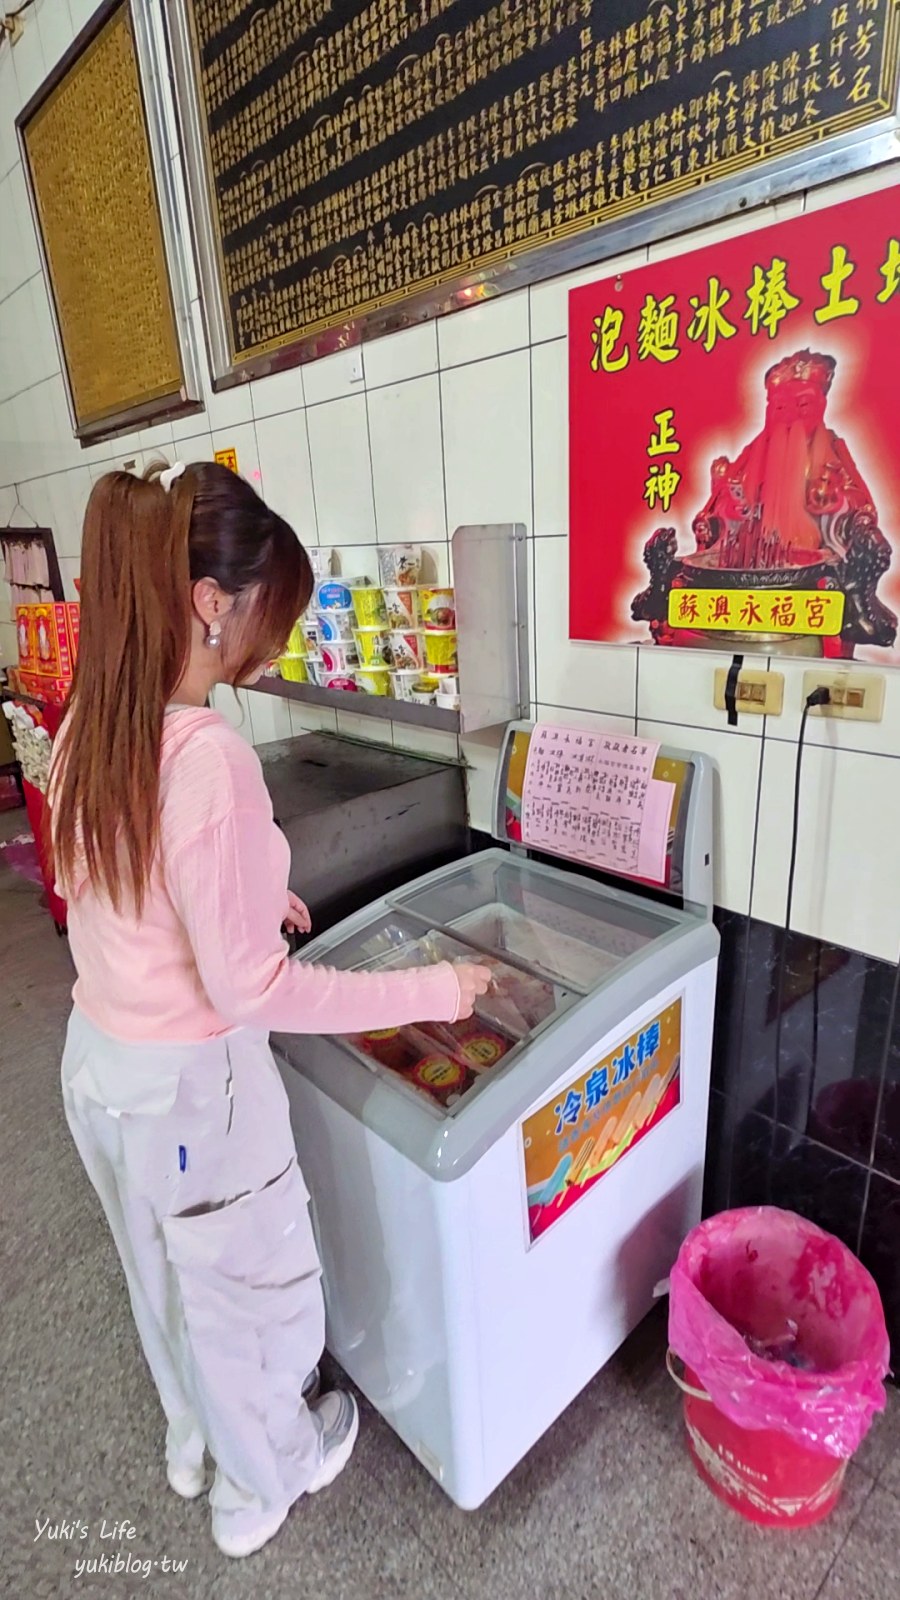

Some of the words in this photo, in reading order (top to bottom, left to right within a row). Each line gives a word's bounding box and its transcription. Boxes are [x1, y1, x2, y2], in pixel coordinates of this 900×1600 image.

[644, 408, 682, 513] 正神
[676, 592, 833, 631] 蘇澳永福宮
[554, 1020, 662, 1135] 冷泉冰棒
